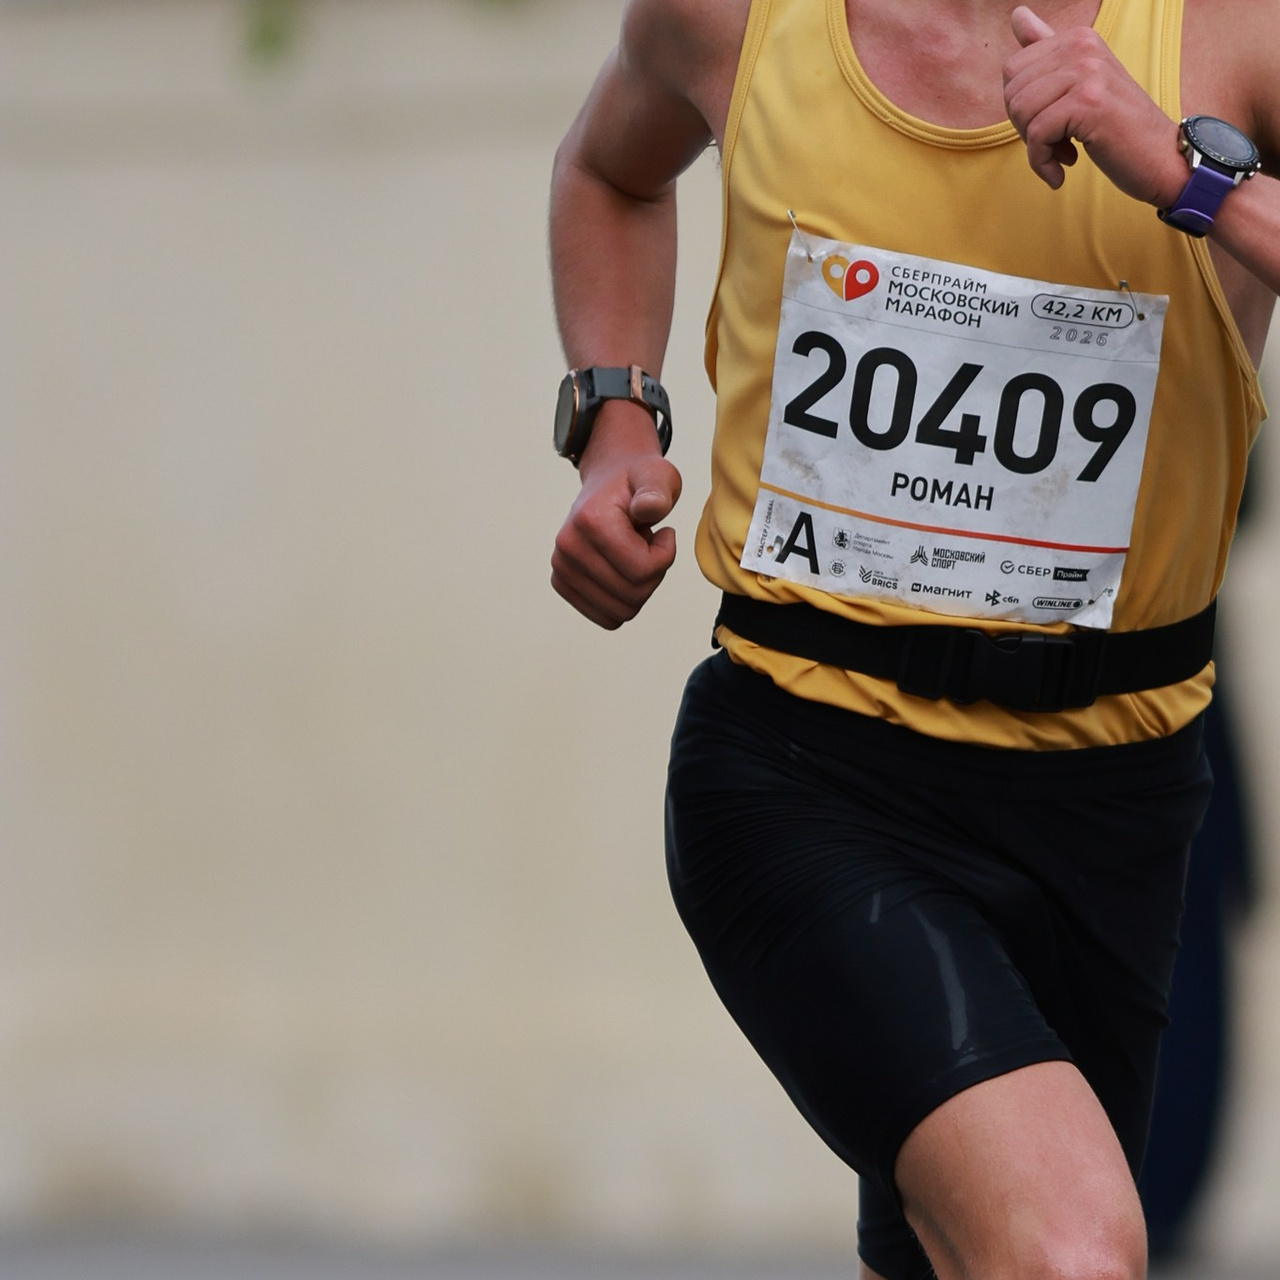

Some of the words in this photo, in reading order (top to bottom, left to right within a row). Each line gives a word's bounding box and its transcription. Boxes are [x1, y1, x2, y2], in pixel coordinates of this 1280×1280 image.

[891, 266, 988, 294] СБЕРПРАЙМ
[888, 280, 1020, 318] МОСКОВСКИЙ
[885, 297, 982, 328] МАРАФОН
[1042, 300, 1085, 319] 42,2
[1049, 325, 1109, 347] 2026
[783, 330, 1137, 482] 20409
[890, 472, 994, 511] РОМАН
[931, 558, 957, 570] СПОРТ
[932, 547, 986, 564] МОСКОВСКИЙ
[1017, 565, 1051, 577] СБЕР
[1056, 570, 1083, 579] Прайм
[871, 578, 898, 590] BRICS
[1036, 599, 1073, 608] WINLINE
